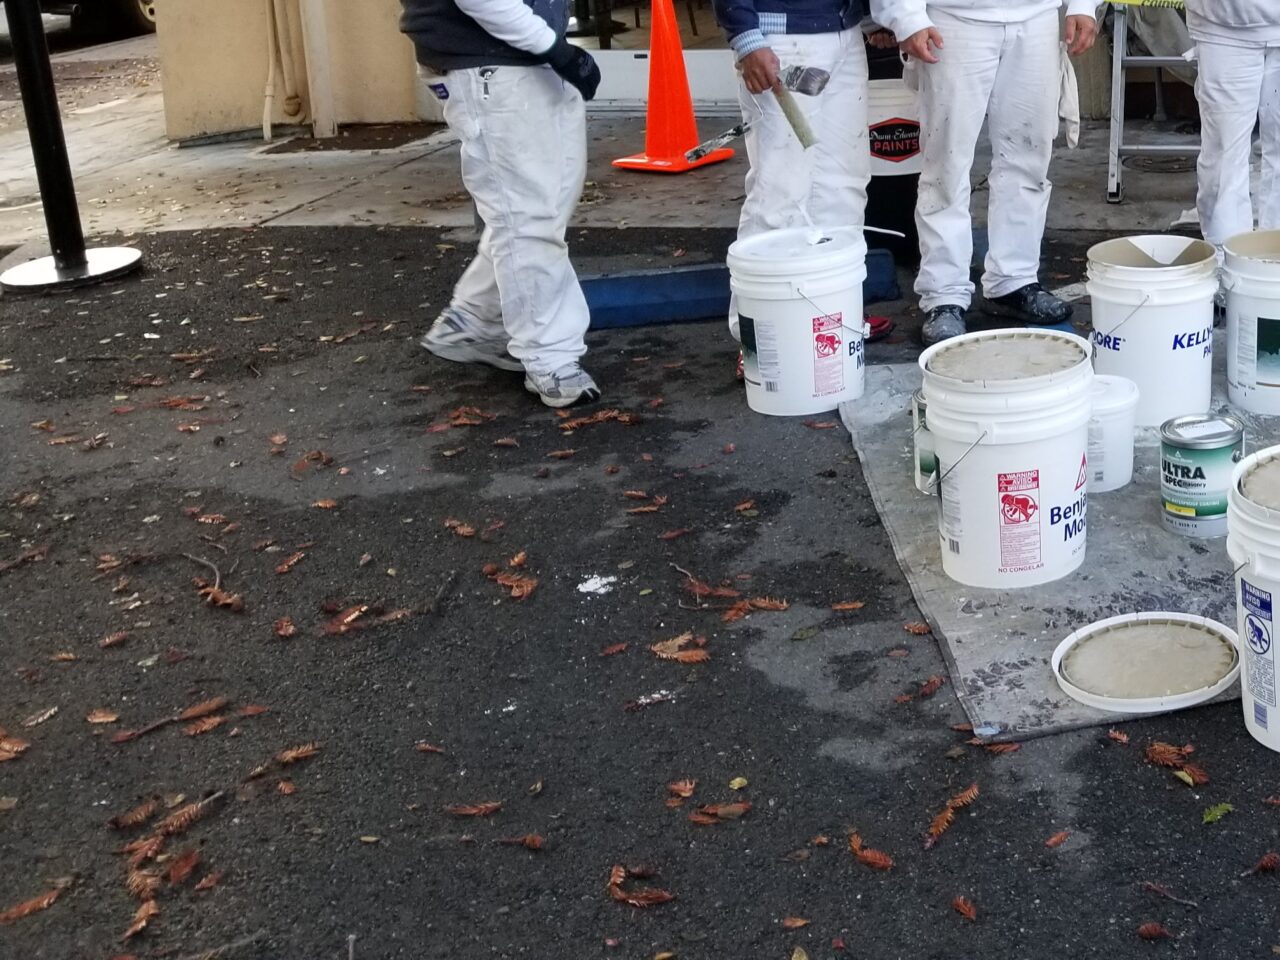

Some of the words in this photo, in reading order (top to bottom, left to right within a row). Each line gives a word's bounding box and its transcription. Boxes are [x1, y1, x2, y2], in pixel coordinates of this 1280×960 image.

[874, 139, 918, 152] PAINTS
[1161, 458, 1206, 480] ULTRA
[1164, 474, 1183, 488] SPEC
[1009, 562, 1044, 573] CONGELAR
